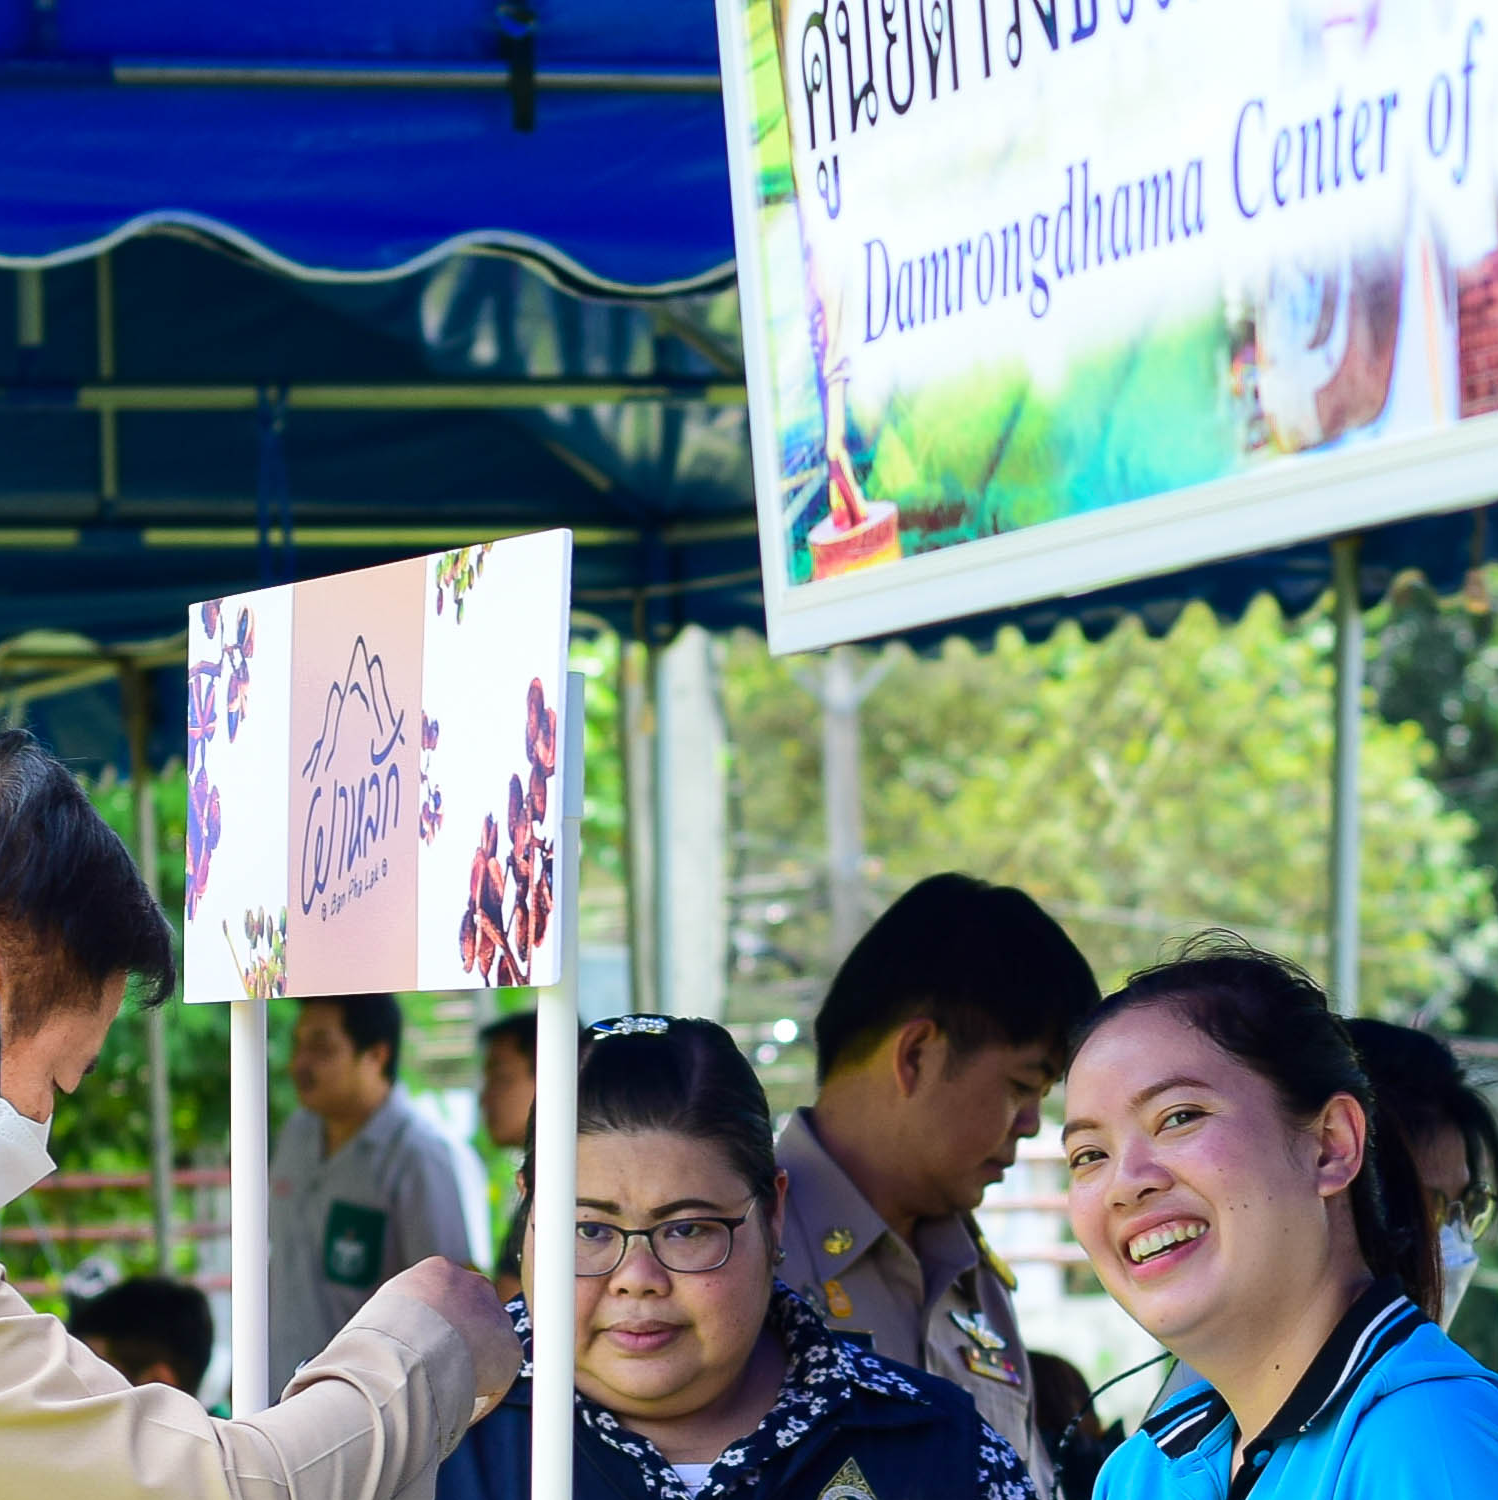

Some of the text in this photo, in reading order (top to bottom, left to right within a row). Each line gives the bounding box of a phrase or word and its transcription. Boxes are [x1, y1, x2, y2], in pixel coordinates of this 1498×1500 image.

[863, 158, 1204, 344] Damrongdhama
[1232, 86, 1399, 220] Center
[1426, 17, 1484, 186] of
